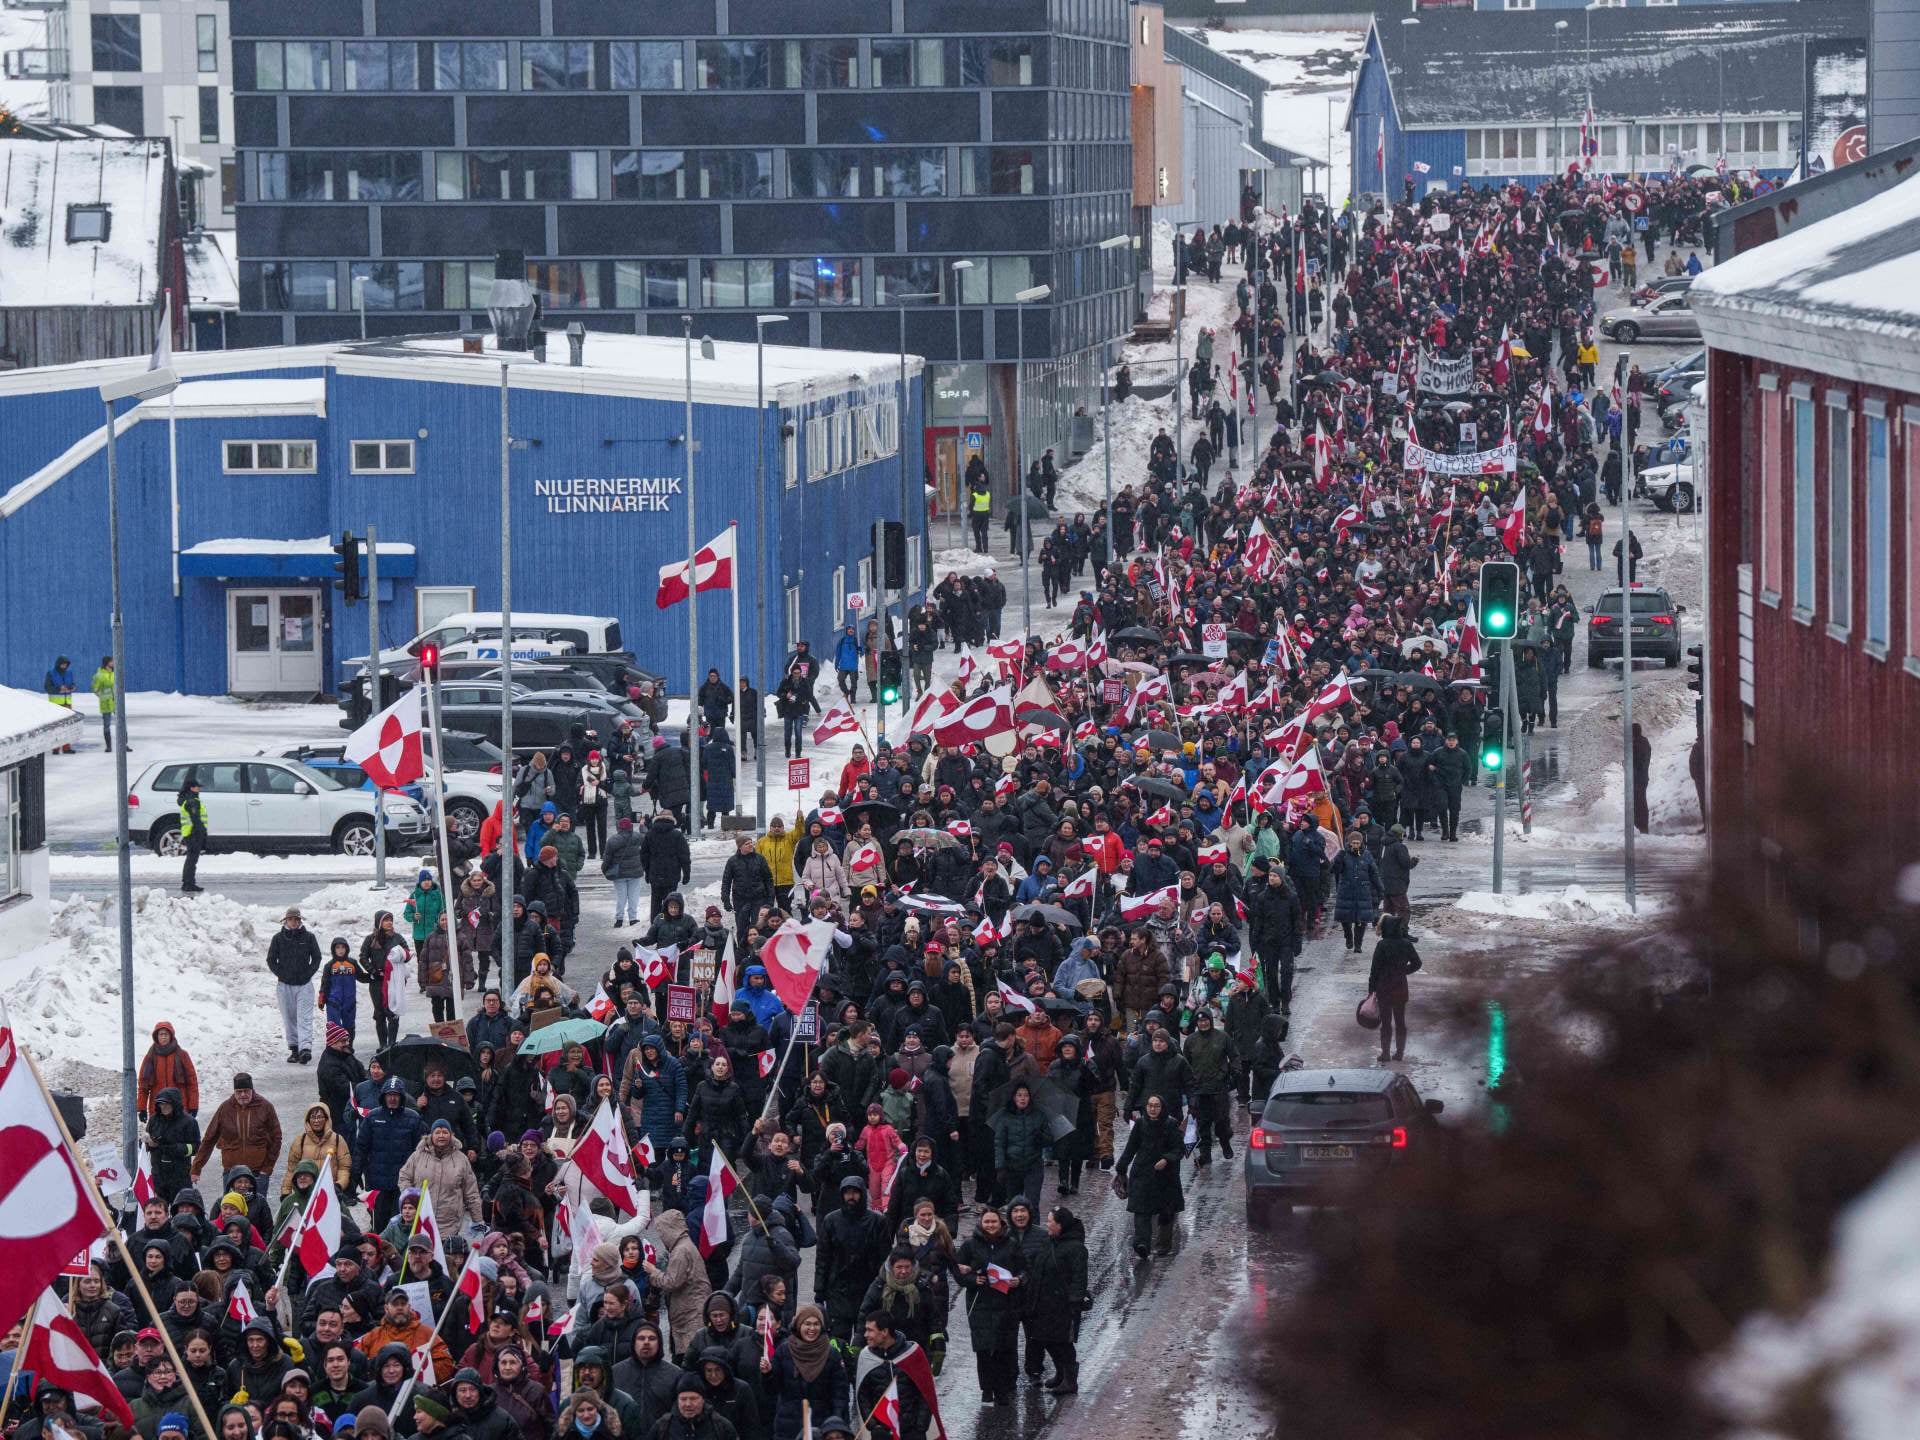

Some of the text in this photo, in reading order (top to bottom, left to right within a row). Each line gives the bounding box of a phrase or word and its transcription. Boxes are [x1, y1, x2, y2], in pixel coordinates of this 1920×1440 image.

[1421, 371, 1442, 389] GO
[940, 390, 970, 399] SPAR
[1490, 443, 1516, 459] OUR
[1424, 457, 1480, 474] FUTURE
[534, 477, 682, 496] NIUERNERMIK
[548, 495, 670, 513] ILINNIARFIK
[693, 966, 715, 979] NO!
[670, 1006, 693, 1019] SALE!
